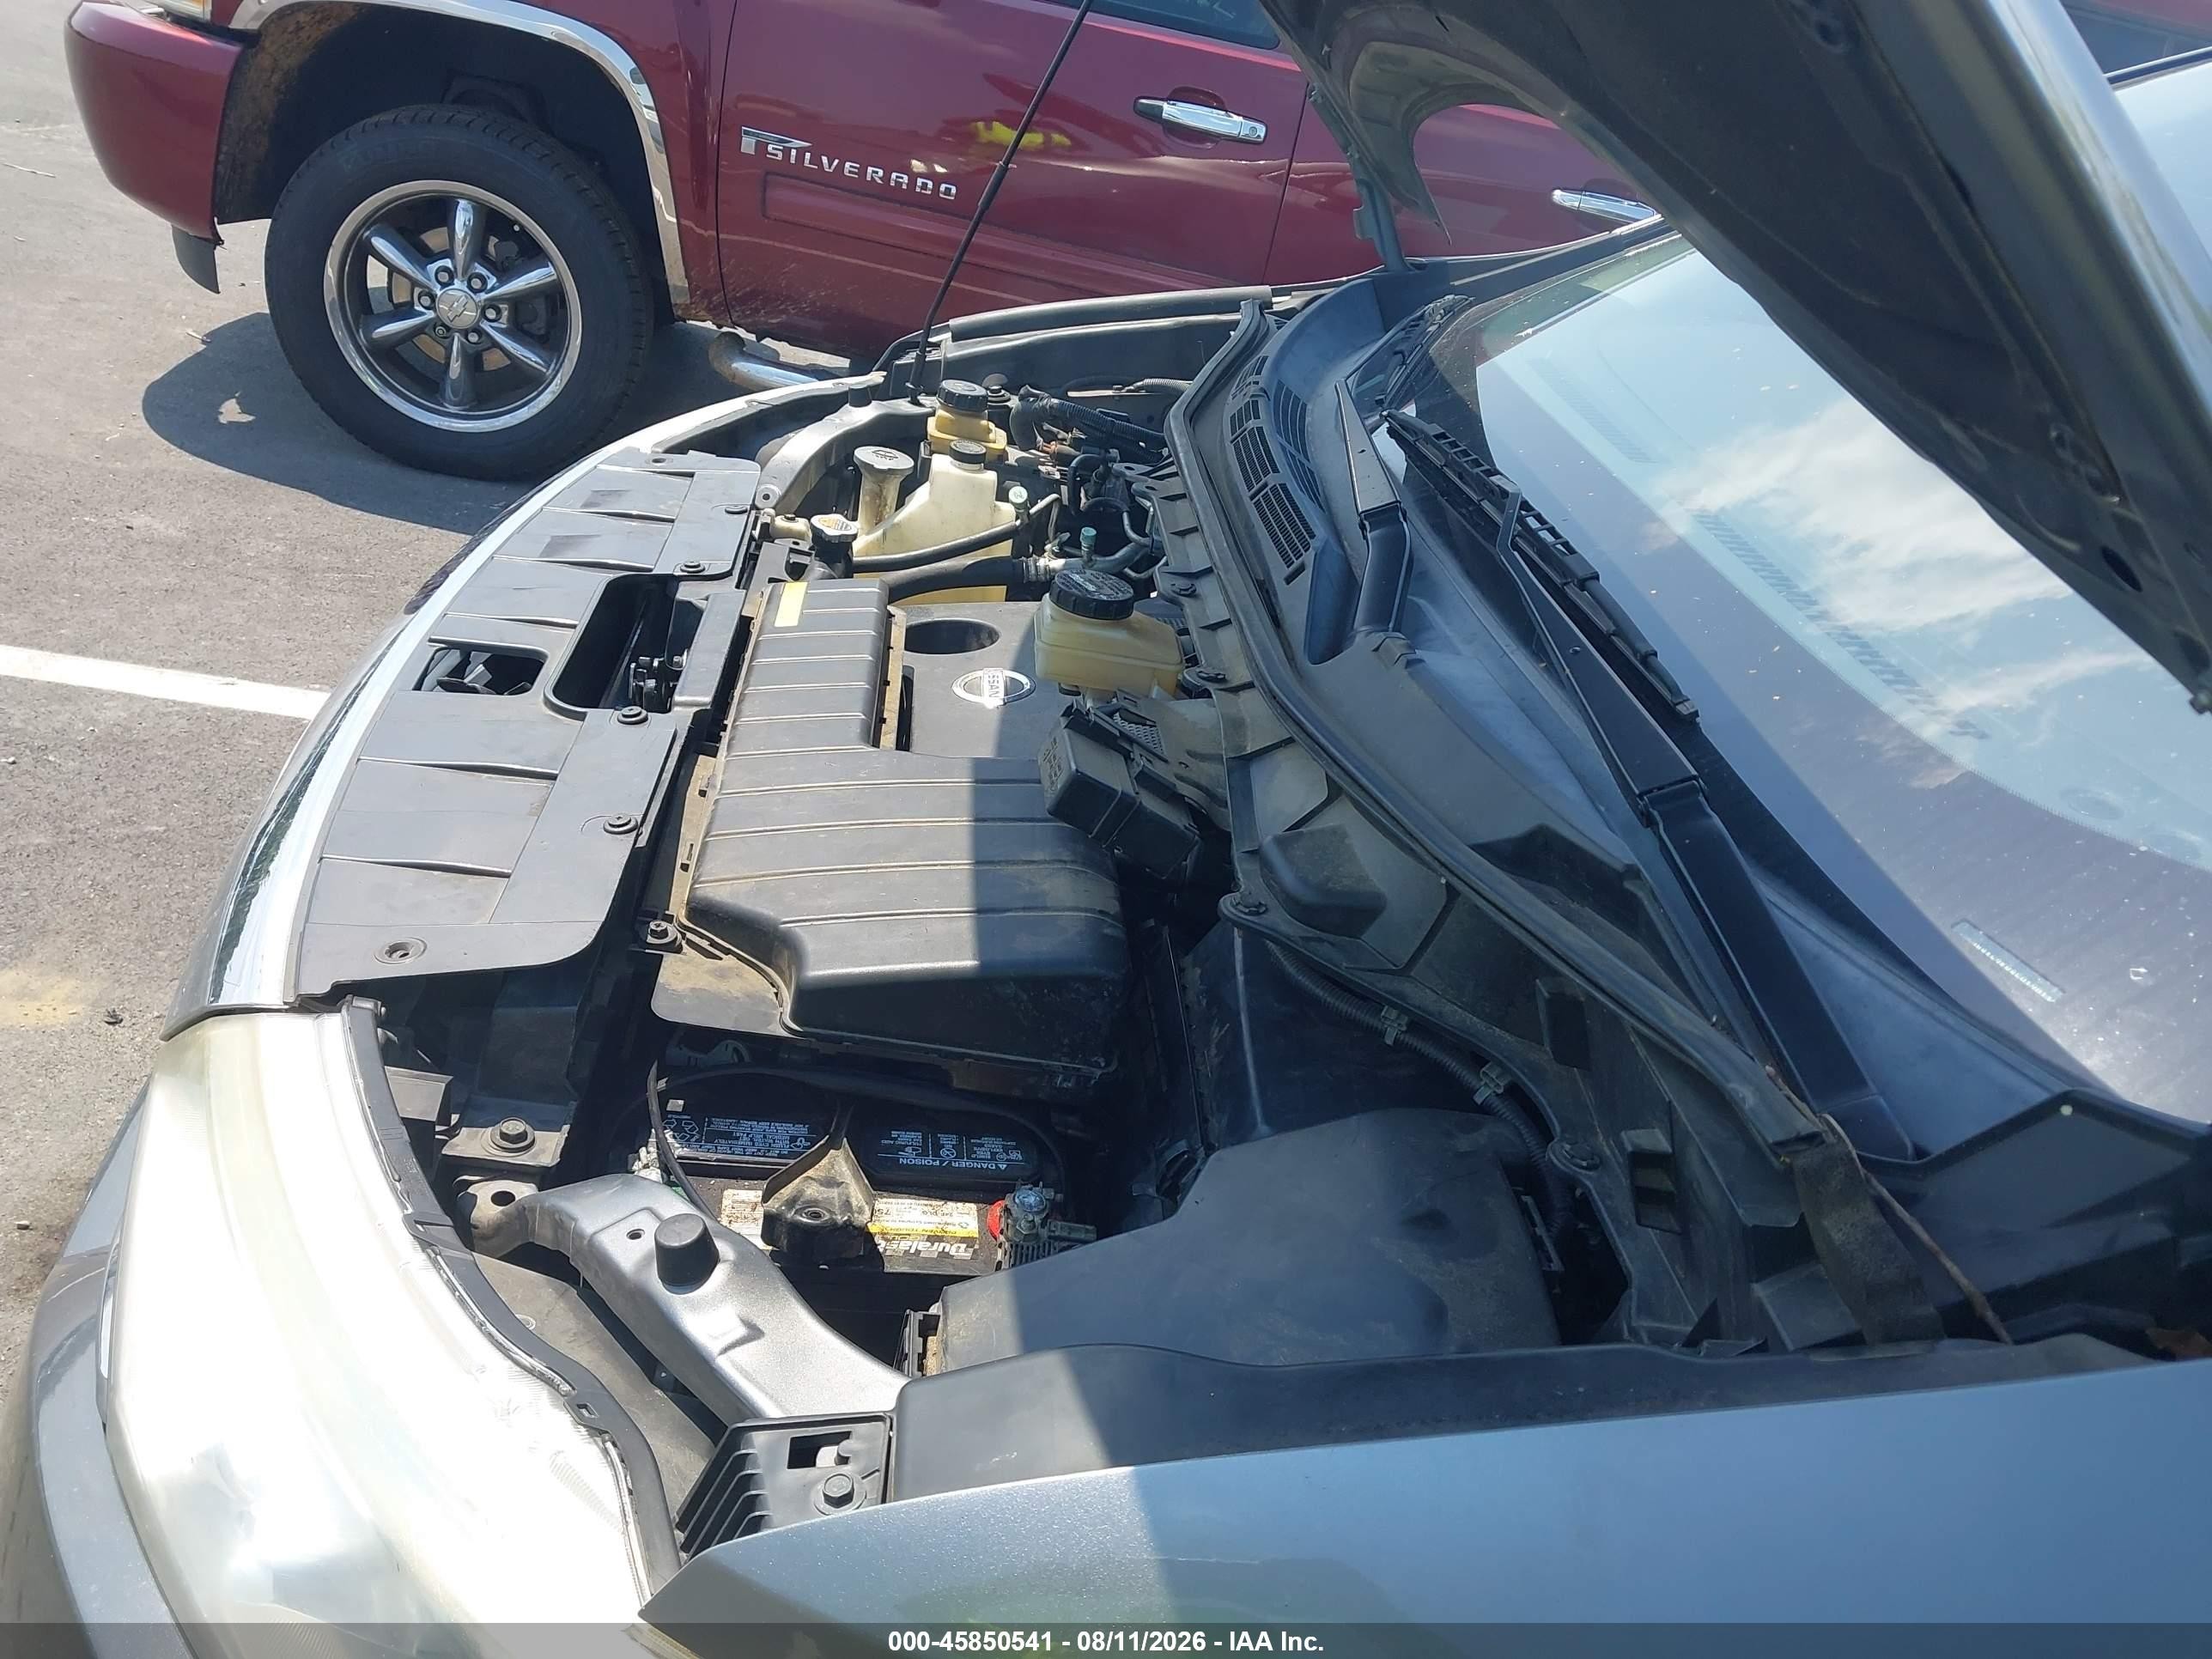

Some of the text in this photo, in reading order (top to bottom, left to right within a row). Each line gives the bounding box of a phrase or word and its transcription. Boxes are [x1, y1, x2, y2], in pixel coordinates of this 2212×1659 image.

[766, 143, 957, 200] SILVERADO
[899, 1158, 940, 1166] POISON
[951, 1161, 996, 1170] DANGER
[878, 1240, 970, 1256] Duralast
